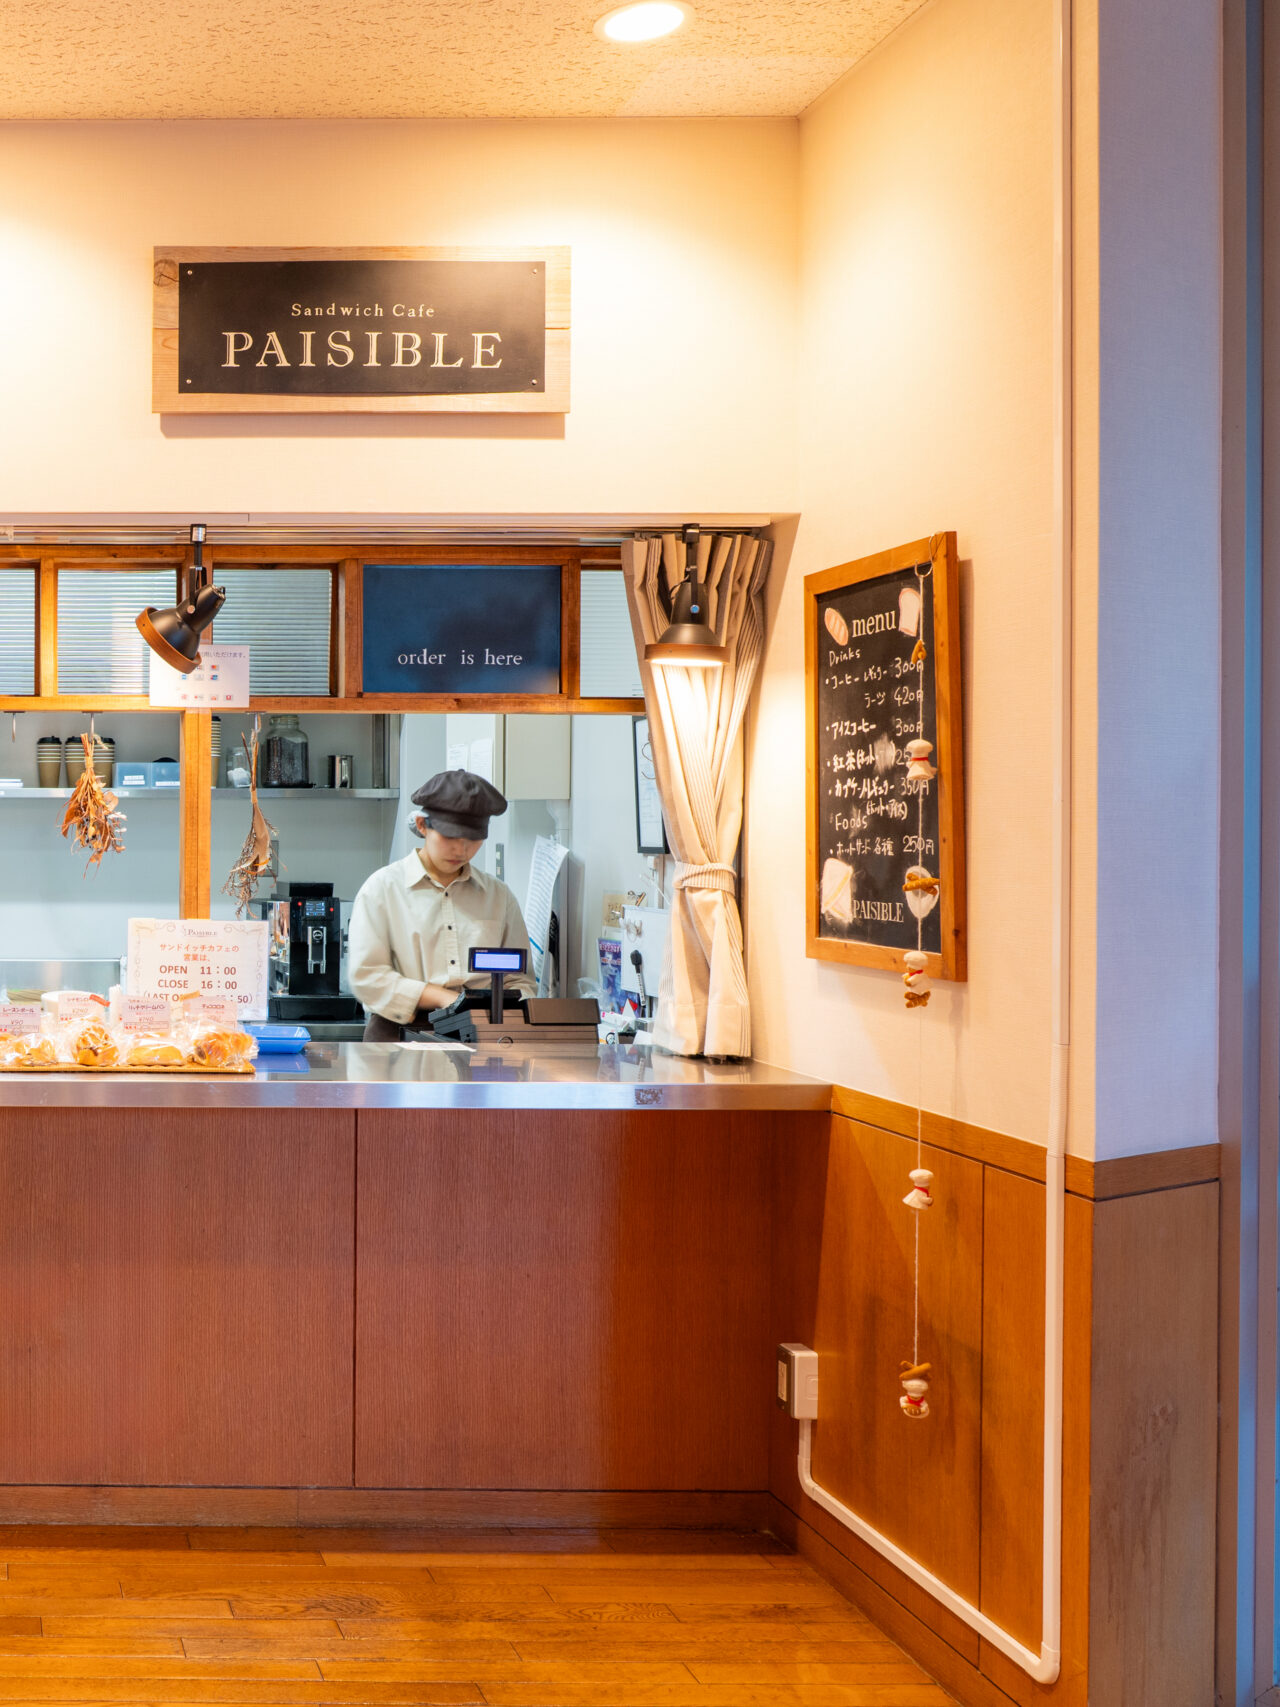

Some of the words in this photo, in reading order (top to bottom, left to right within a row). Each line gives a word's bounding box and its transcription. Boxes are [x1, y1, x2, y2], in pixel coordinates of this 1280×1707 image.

[291, 303, 384, 318] Sandwich
[392, 303, 435, 318] Cafe
[221, 330, 503, 369] PAISIBLE
[851, 611, 897, 638] menu
[397, 648, 446, 665] order
[460, 649, 474, 665] is
[484, 648, 523, 665] here
[829, 648, 860, 667] Drinks
[831, 673, 860, 689] コーヒー
[831, 718, 877, 740] アイスコーヒー
[835, 808, 868, 831] Foods
[874, 837, 895, 856] 各種
[903, 835, 935, 856] 250円
[852, 899, 904, 923] PAISIBLE
[160, 944, 240, 953] サンドイッチカフェの
[159, 965, 188, 975] OPEN
[157, 979, 189, 989] CLOSE
